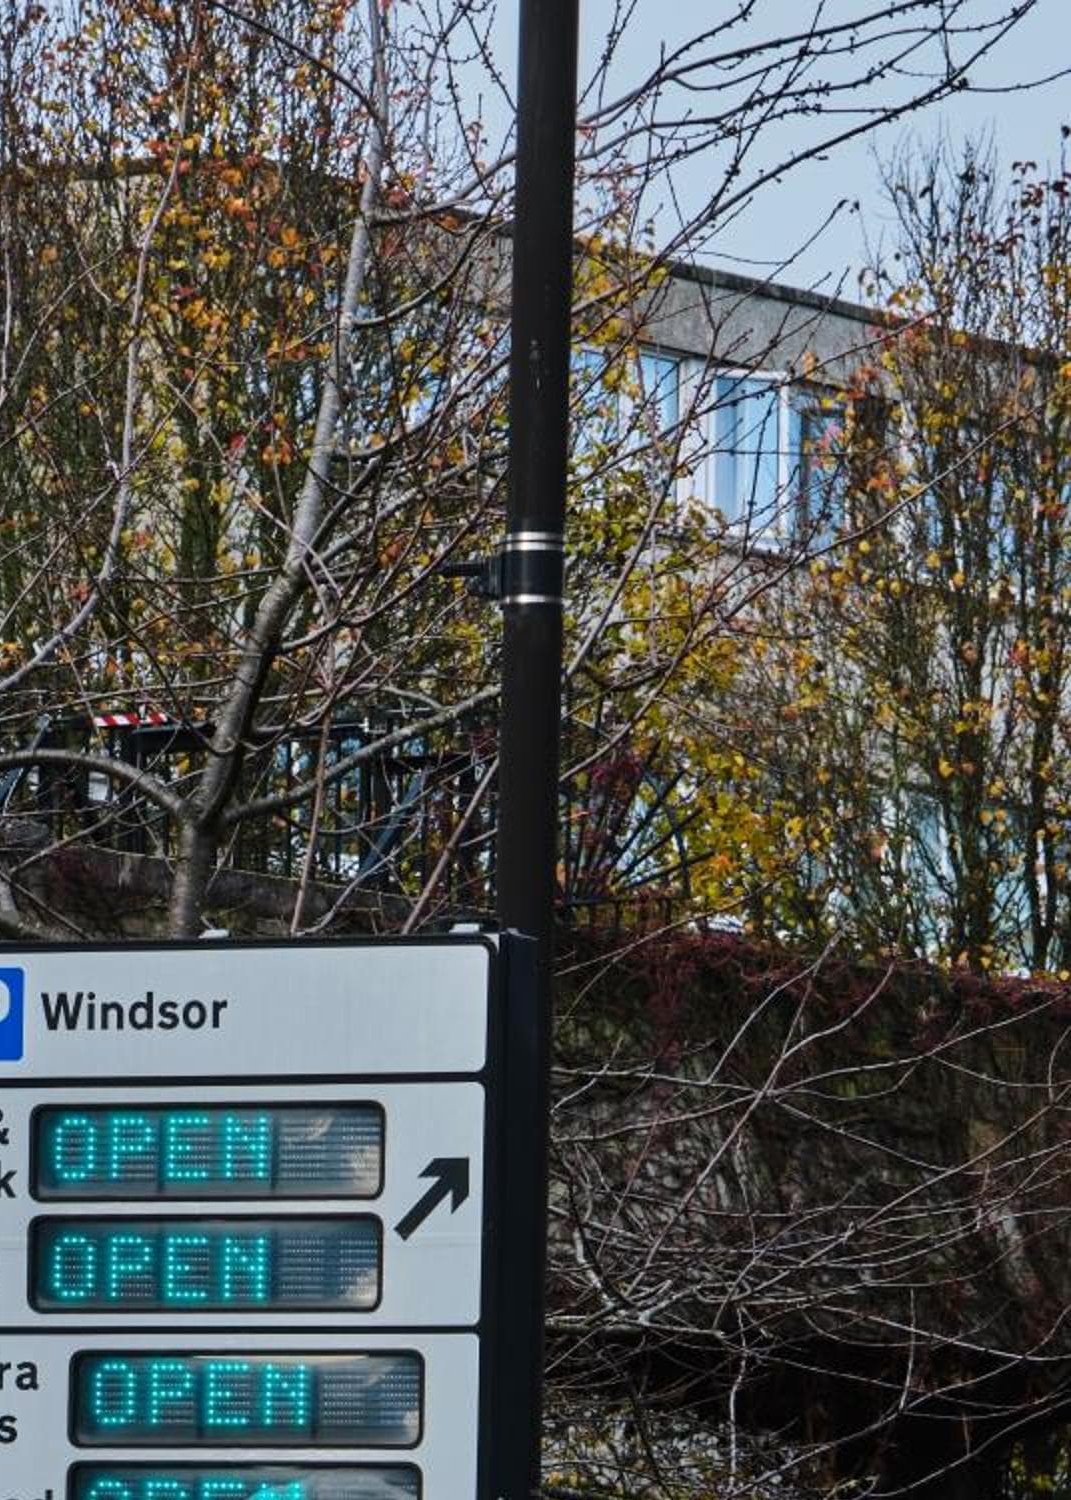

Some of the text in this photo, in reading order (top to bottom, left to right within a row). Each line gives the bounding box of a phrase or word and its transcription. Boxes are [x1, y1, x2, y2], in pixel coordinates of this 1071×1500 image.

[40, 991, 228, 1031] Windsor
[52, 1116, 270, 1181] OPEN
[51, 1235, 267, 1300] OPEN
[94, 1361, 309, 1427] OPEN
